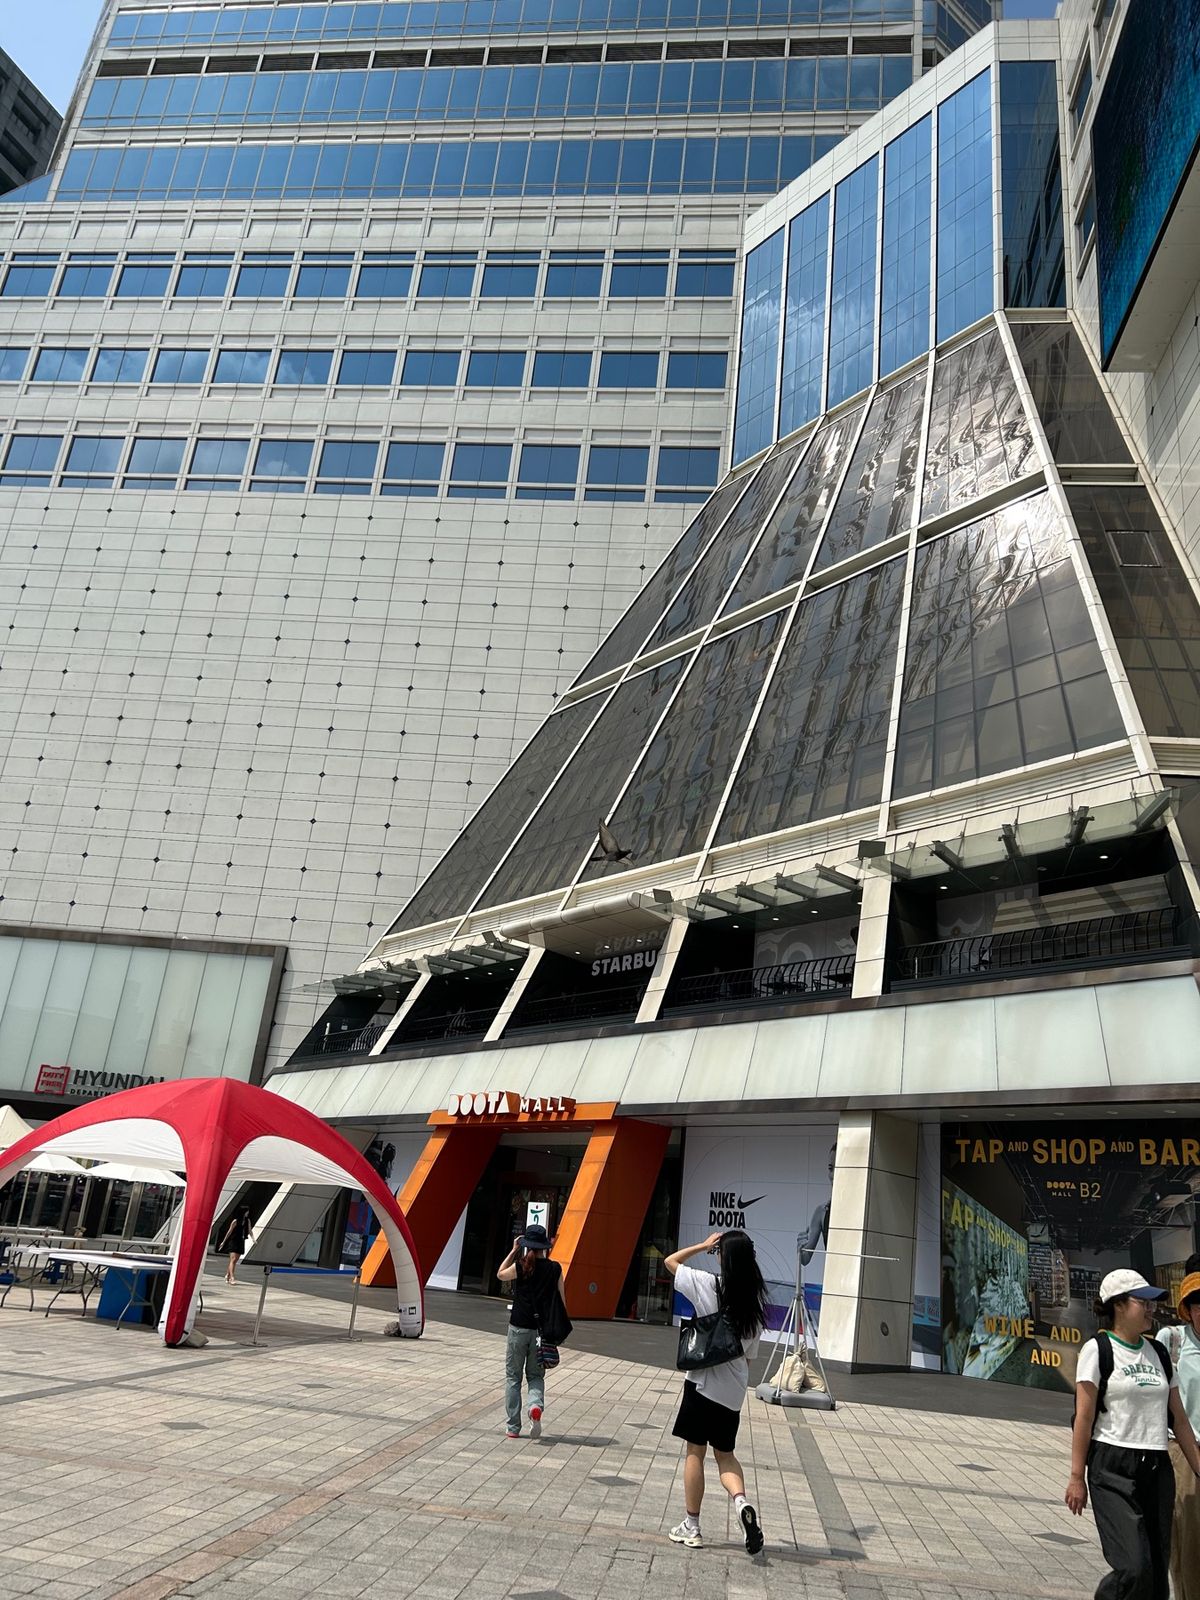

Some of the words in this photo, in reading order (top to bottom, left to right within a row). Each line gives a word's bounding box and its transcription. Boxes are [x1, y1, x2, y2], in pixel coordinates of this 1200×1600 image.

[591, 950, 659, 976] STARBU
[41, 1079, 63, 1087] FREE
[43, 1071, 64, 1079] DUTY
[448, 1091, 511, 1116] DOOTA
[520, 1096, 566, 1113] MALL
[955, 1139, 1004, 1163] TAP
[1008, 1141, 1029, 1152] AND
[1032, 1138, 1105, 1164] SHOP
[1110, 1141, 1134, 1153] AND
[1139, 1138, 1200, 1166] BAR
[1046, 1181, 1077, 1190] DOOTA
[1080, 1182, 1102, 1198] B2
[709, 1191, 736, 1209] NIKE
[708, 1209, 746, 1229] DOOTA
[988, 1222, 1011, 1250] SHOP
[984, 1314, 1035, 1339] WINE
[1050, 1325, 1082, 1344] AND
[1030, 1348, 1062, 1368] AND
[1121, 1363, 1162, 1378] BREEZE
